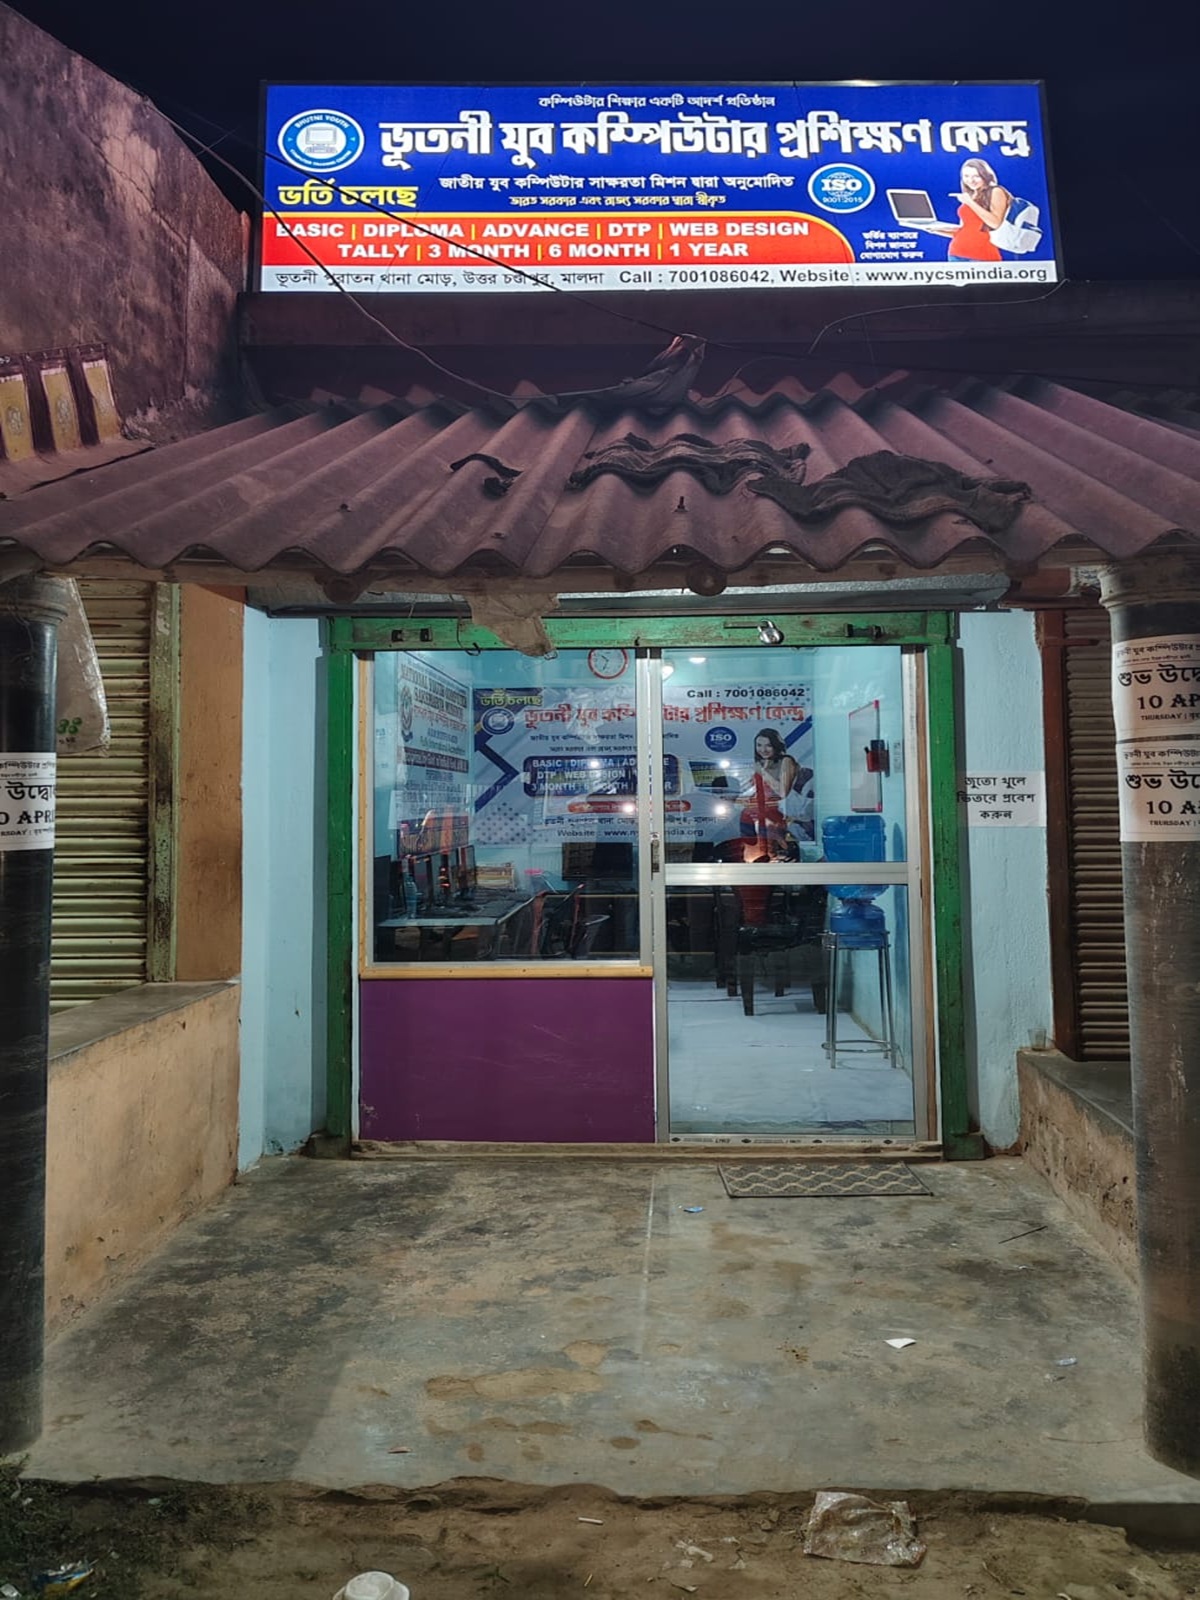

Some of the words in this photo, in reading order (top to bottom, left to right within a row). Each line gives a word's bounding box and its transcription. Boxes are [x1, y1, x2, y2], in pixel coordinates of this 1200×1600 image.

[649, 93, 684, 107] একটি
[378, 110, 493, 170] ভূতনী
[498, 122, 555, 169] যুব
[560, 111, 769, 158] কম্পিউটার
[776, 110, 933, 158] প্রশিক্ষণ
[940, 120, 1030, 157] কেন্দ্র
[438, 174, 485, 190] জাতীয়
[489, 176, 511, 192] যুব
[513, 174, 585, 190] কম্পিউটার
[589, 176, 646, 190] সাক্ষরতা
[649, 174, 687, 189] মিশন
[690, 175, 719, 188] দ্বারা
[722, 173, 795, 191] অনুমোদিত
[821, 179, 862, 191] ISO
[278, 177, 336, 205] ভর্তি
[338, 186, 419, 208] চলছে
[276, 223, 344, 237] BASIC
[363, 223, 464, 237] DIPLOMA
[482, 223, 589, 237] ADVANCE
[608, 223, 651, 237] DTP
[669, 222, 719, 236] WEB
[726, 222, 809, 236] DESIGN
[338, 244, 409, 258] TALLY
[428, 244, 441, 258] 3
[449, 244, 530, 258] MONTH
[548, 244, 562, 257] 6
[569, 243, 650, 257] MONTH
[669, 243, 680, 256] 1
[688, 243, 749, 256] YEAR
[380, 272, 412, 284] থানা
[560, 272, 604, 284] মালদা
[619, 270, 652, 283] Call
[669, 270, 775, 285] 7001086042,
[780, 269, 849, 282] Website
[866, 267, 1047, 283] www.nycsmindia.org
[1118, 669, 1153, 686] শুভ
[687, 690, 712, 698] Call
[724, 689, 805, 698] 7001086042
[1137, 694, 1163, 709] 10
[1141, 712, 1182, 720] THURSDAY
[710, 733, 732, 742] ISO
[532, 759, 562, 768] BASIC
[565, 770, 586, 779] WEB
[1125, 774, 1164, 789] শুভ
[1146, 800, 1173, 814] 10
